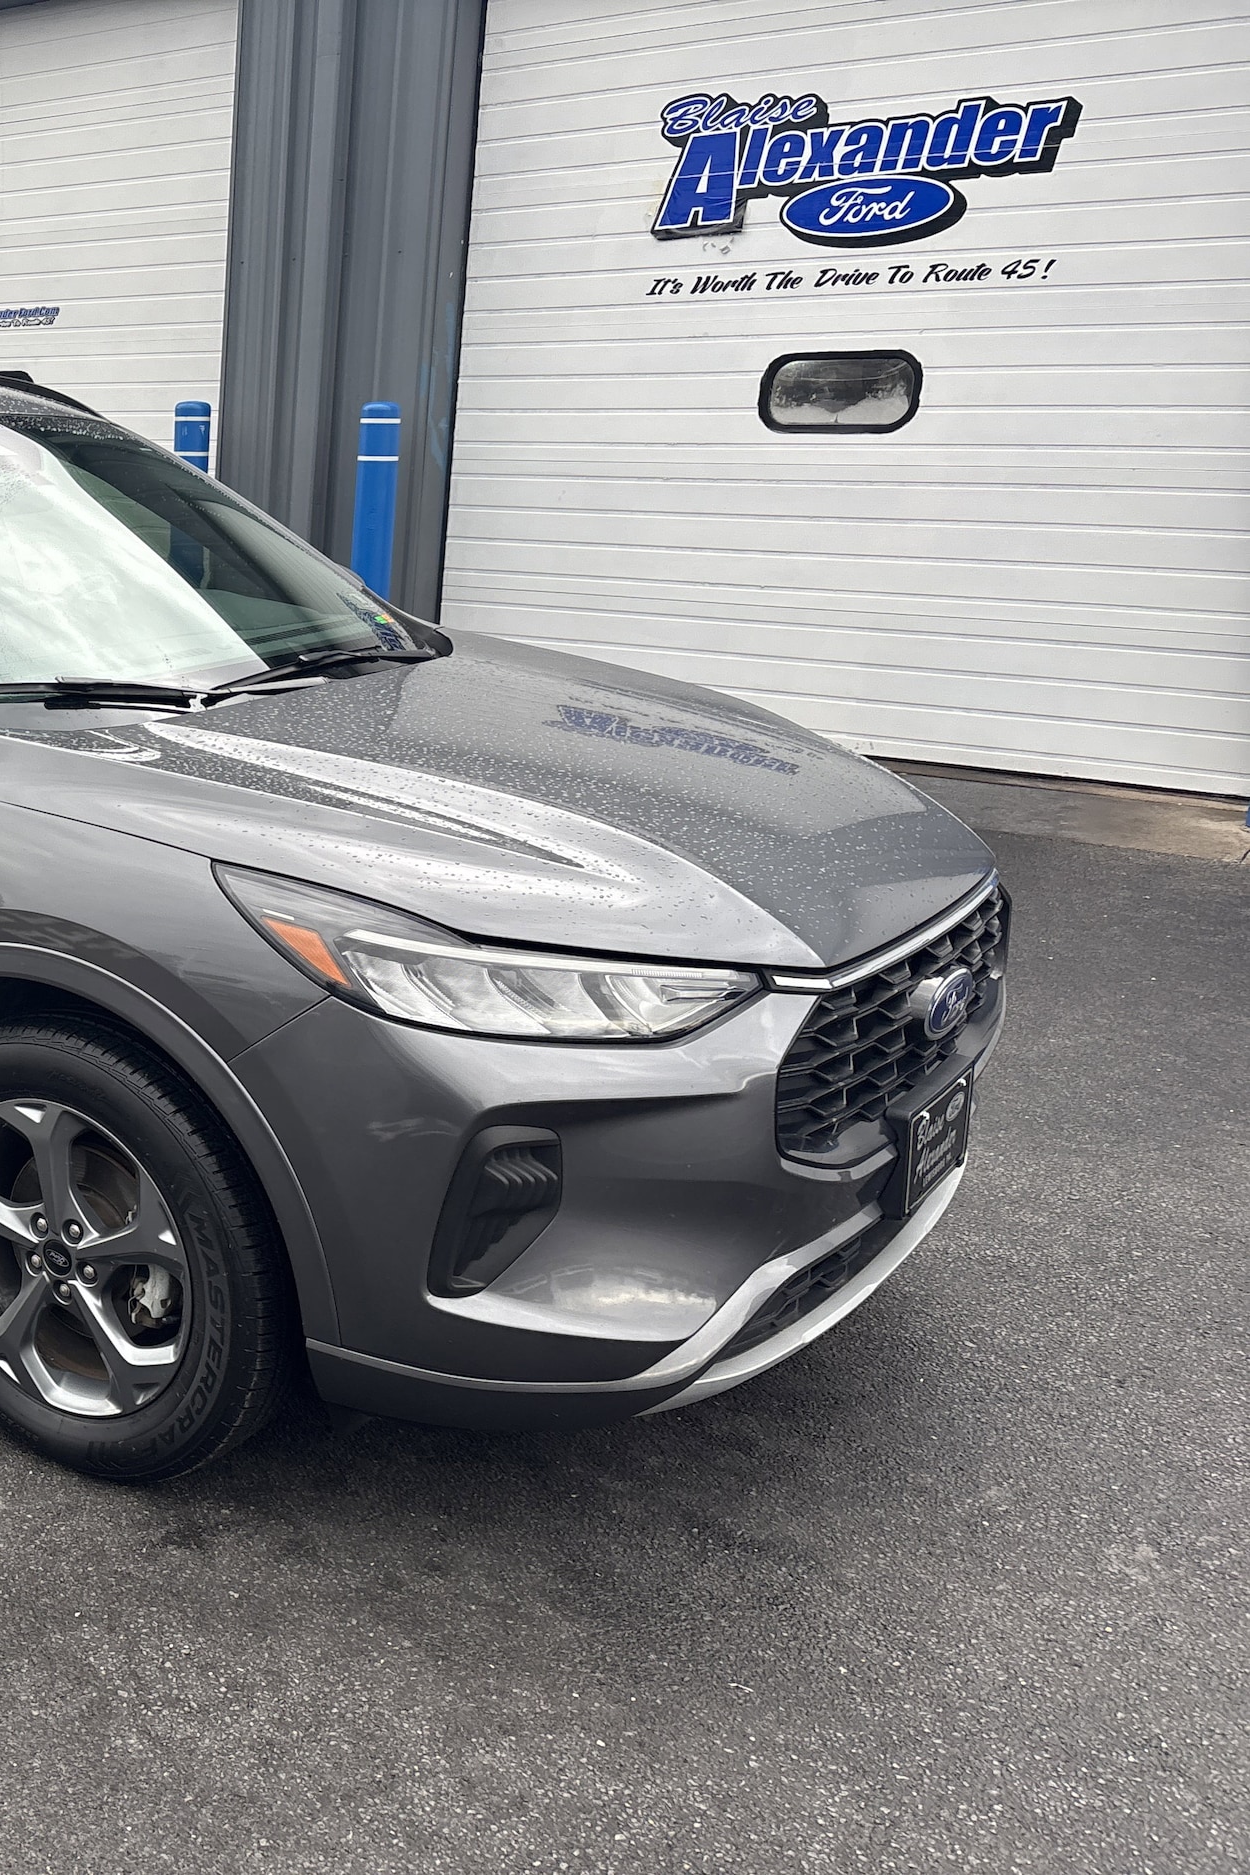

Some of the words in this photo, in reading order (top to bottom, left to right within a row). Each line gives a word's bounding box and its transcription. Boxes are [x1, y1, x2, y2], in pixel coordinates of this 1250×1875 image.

[663, 95, 818, 137] Blaise
[653, 97, 1070, 231] Alexander
[818, 185, 914, 226] Ford
[646, 277, 683, 296] It's
[690, 271, 757, 295] Worth
[765, 270, 803, 291] The
[814, 268, 880, 288] Drive
[888, 264, 914, 285] To
[922, 262, 993, 284] Route
[1000, 259, 1057, 280] 45!
[940, 982, 969, 1024] Ford
[126, 1213, 227, 1458] MASTERCRAF
